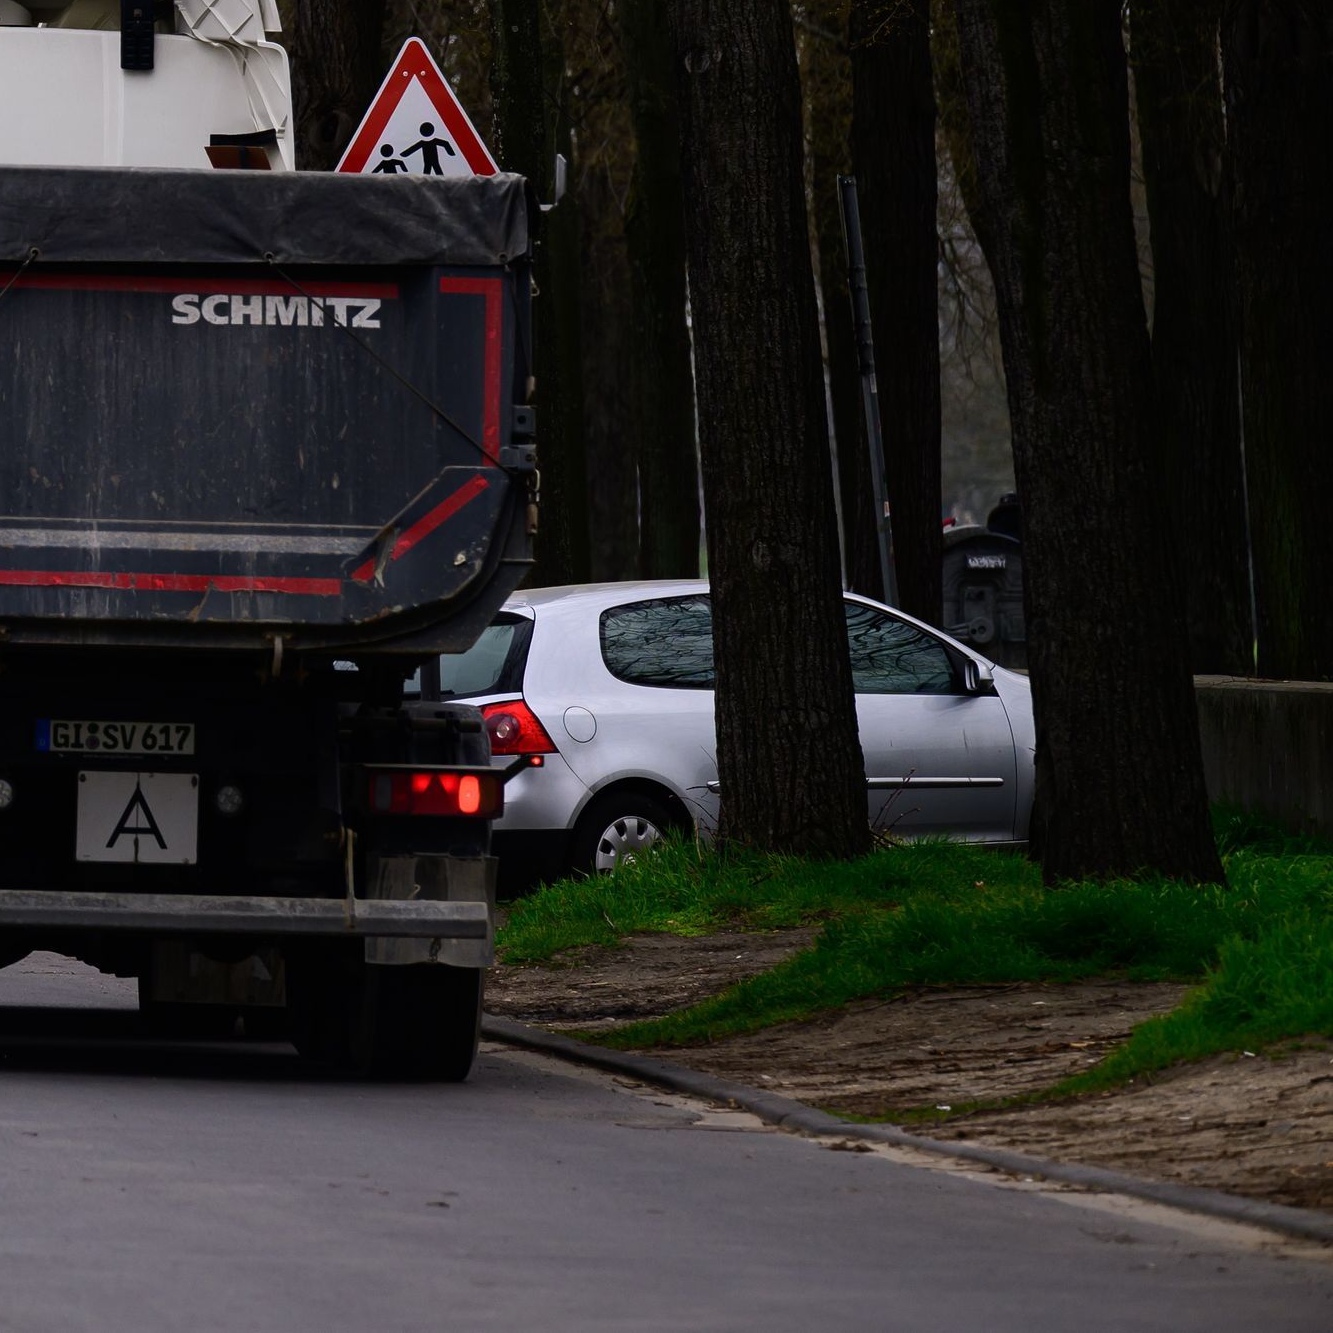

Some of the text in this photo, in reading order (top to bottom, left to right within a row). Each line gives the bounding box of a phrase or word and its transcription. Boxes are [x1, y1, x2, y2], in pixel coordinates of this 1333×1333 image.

[171, 293, 382, 329] SCHMITZ
[52, 722, 84, 749] GI
[102, 723, 137, 750] SV
[141, 724, 191, 751] 617
[105, 785, 168, 850] A
